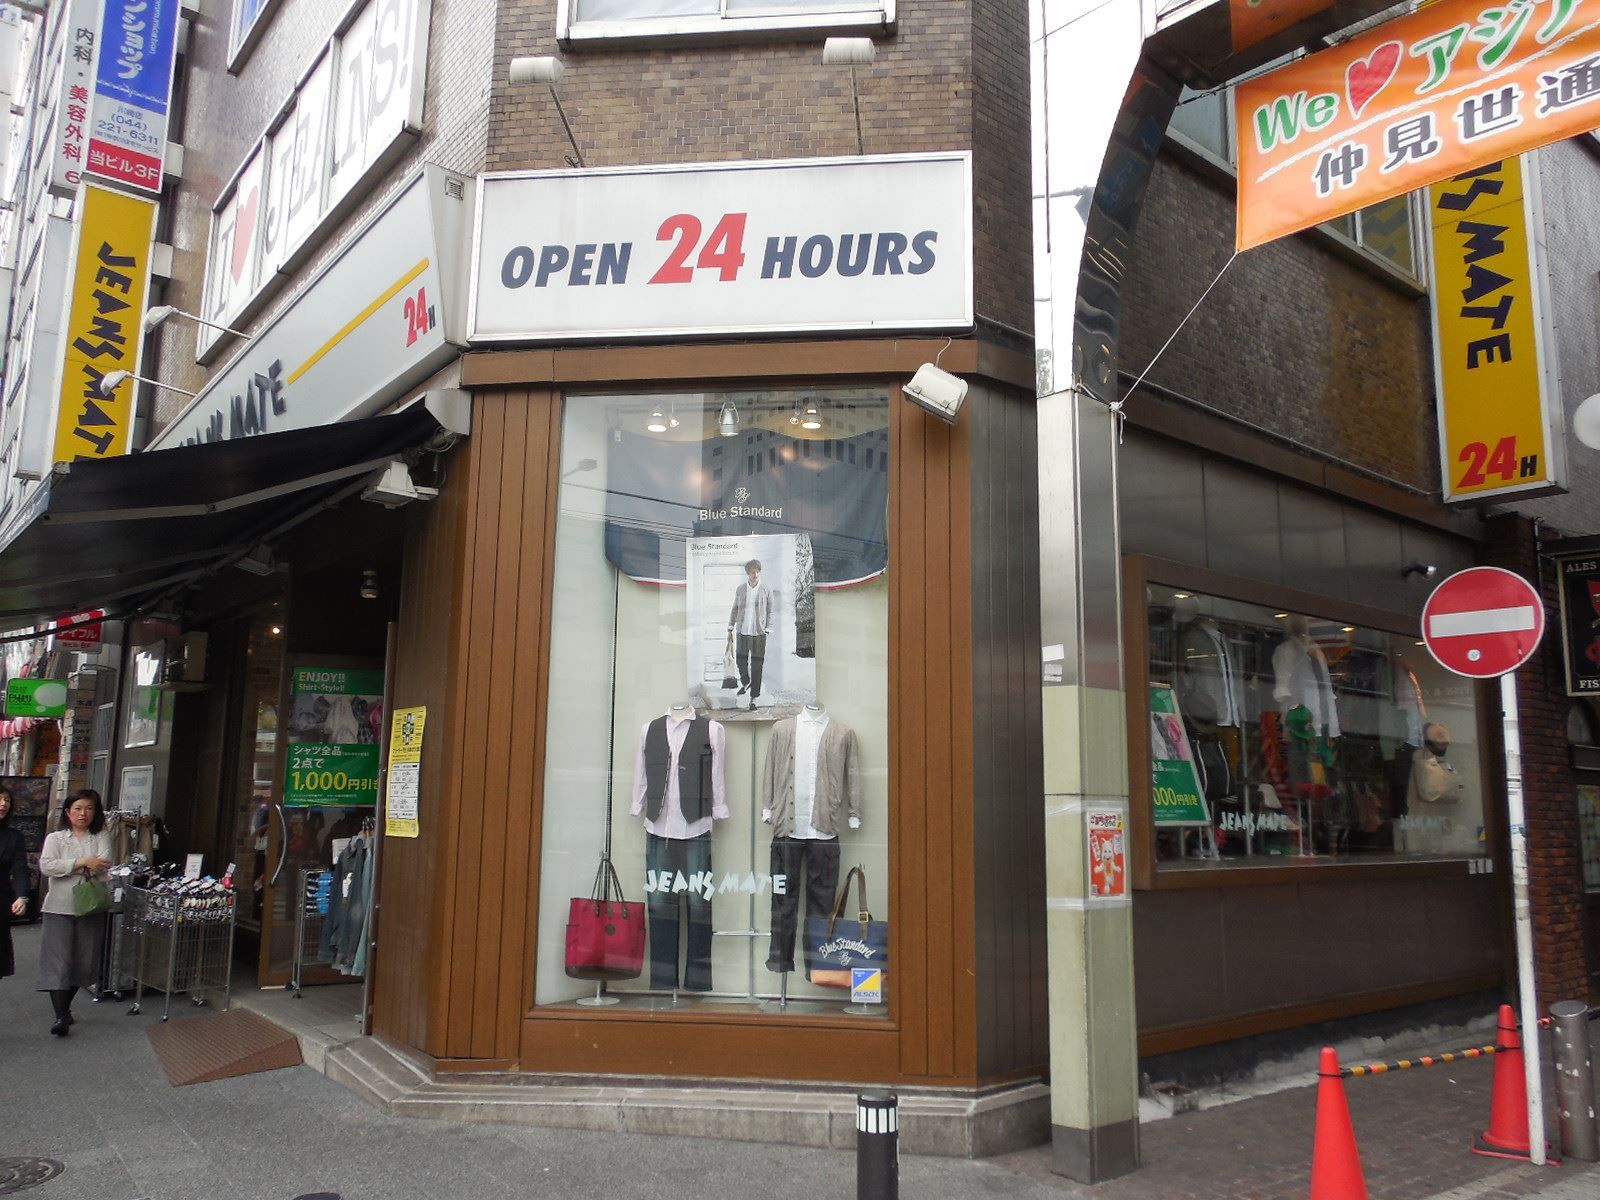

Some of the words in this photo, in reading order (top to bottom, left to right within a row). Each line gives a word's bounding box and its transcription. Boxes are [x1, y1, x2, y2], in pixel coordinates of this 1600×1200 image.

[111, 113, 148, 132] (044)
[1255, 91, 1338, 152] We
[89, 149, 159, 180] 当ビル3F
[500, 242, 633, 289] OPEN
[647, 212, 748, 285] 24
[760, 231, 938, 280] HOURS
[73, 241, 137, 361] JEANS
[1455, 220, 1515, 370] MATE
[73, 364, 122, 462] MAT
[700, 509, 727, 521] Blue
[730, 505, 783, 519] Standard
[690, 543, 706, 551] Blue
[707, 542, 739, 551] Standard
[1566, 562, 1597, 573] ALES
[299, 671, 346, 683] ENJOY!!
[1579, 679, 1600, 690] FIS
[294, 745, 342, 756] シャツ全品
[292, 757, 325, 769] 2点で
[1219, 811, 1255, 836] JEANS
[643, 869, 714, 901] JEANS
[719, 871, 788, 895] MATE
[819, 942, 837, 959] Blue
[835, 937, 877, 959] Standard
